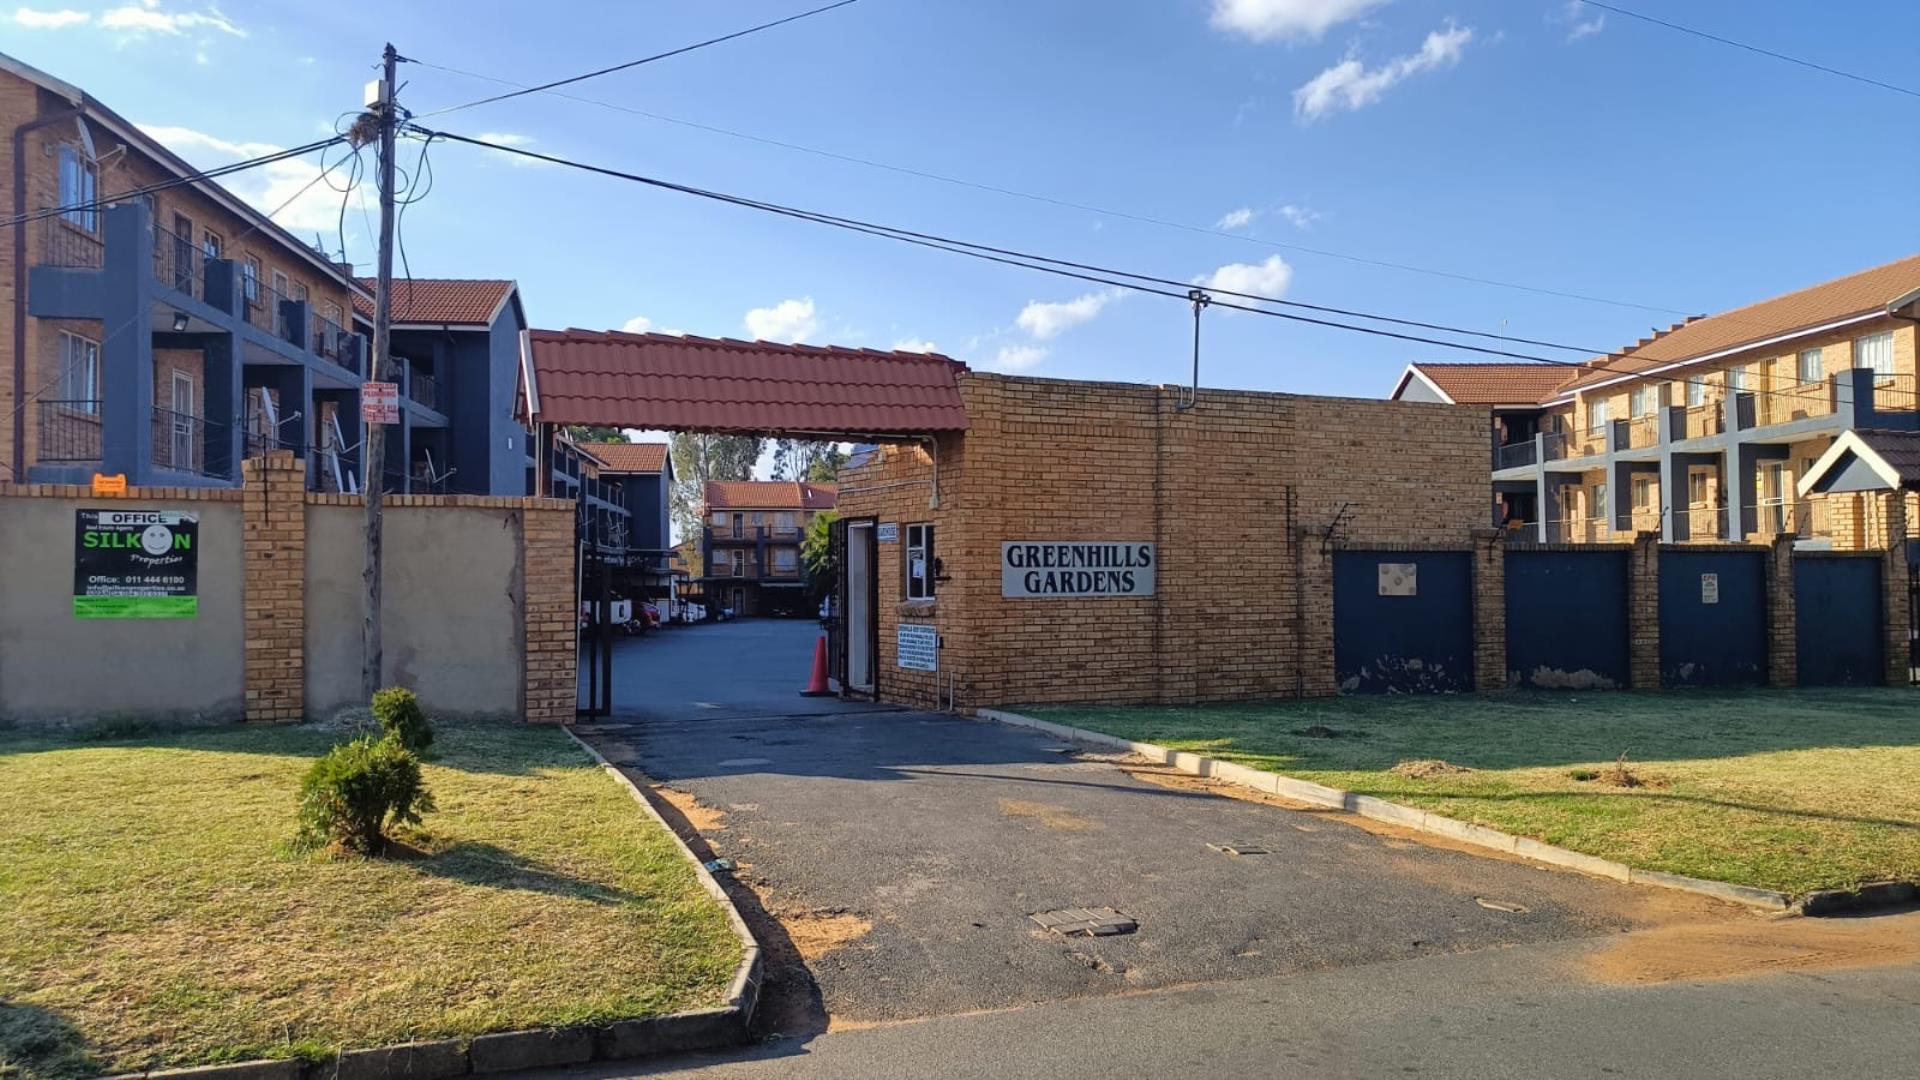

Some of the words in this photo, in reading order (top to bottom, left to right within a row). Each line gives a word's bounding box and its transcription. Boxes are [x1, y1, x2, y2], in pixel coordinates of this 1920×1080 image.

[112, 513, 168, 524] OFFICE
[130, 554, 183, 568] Properties
[1006, 545, 1151, 568] GREENHILLS
[125, 576, 141, 584] 011
[144, 576, 161, 584] 444
[1024, 570, 1136, 593] GARDENS
